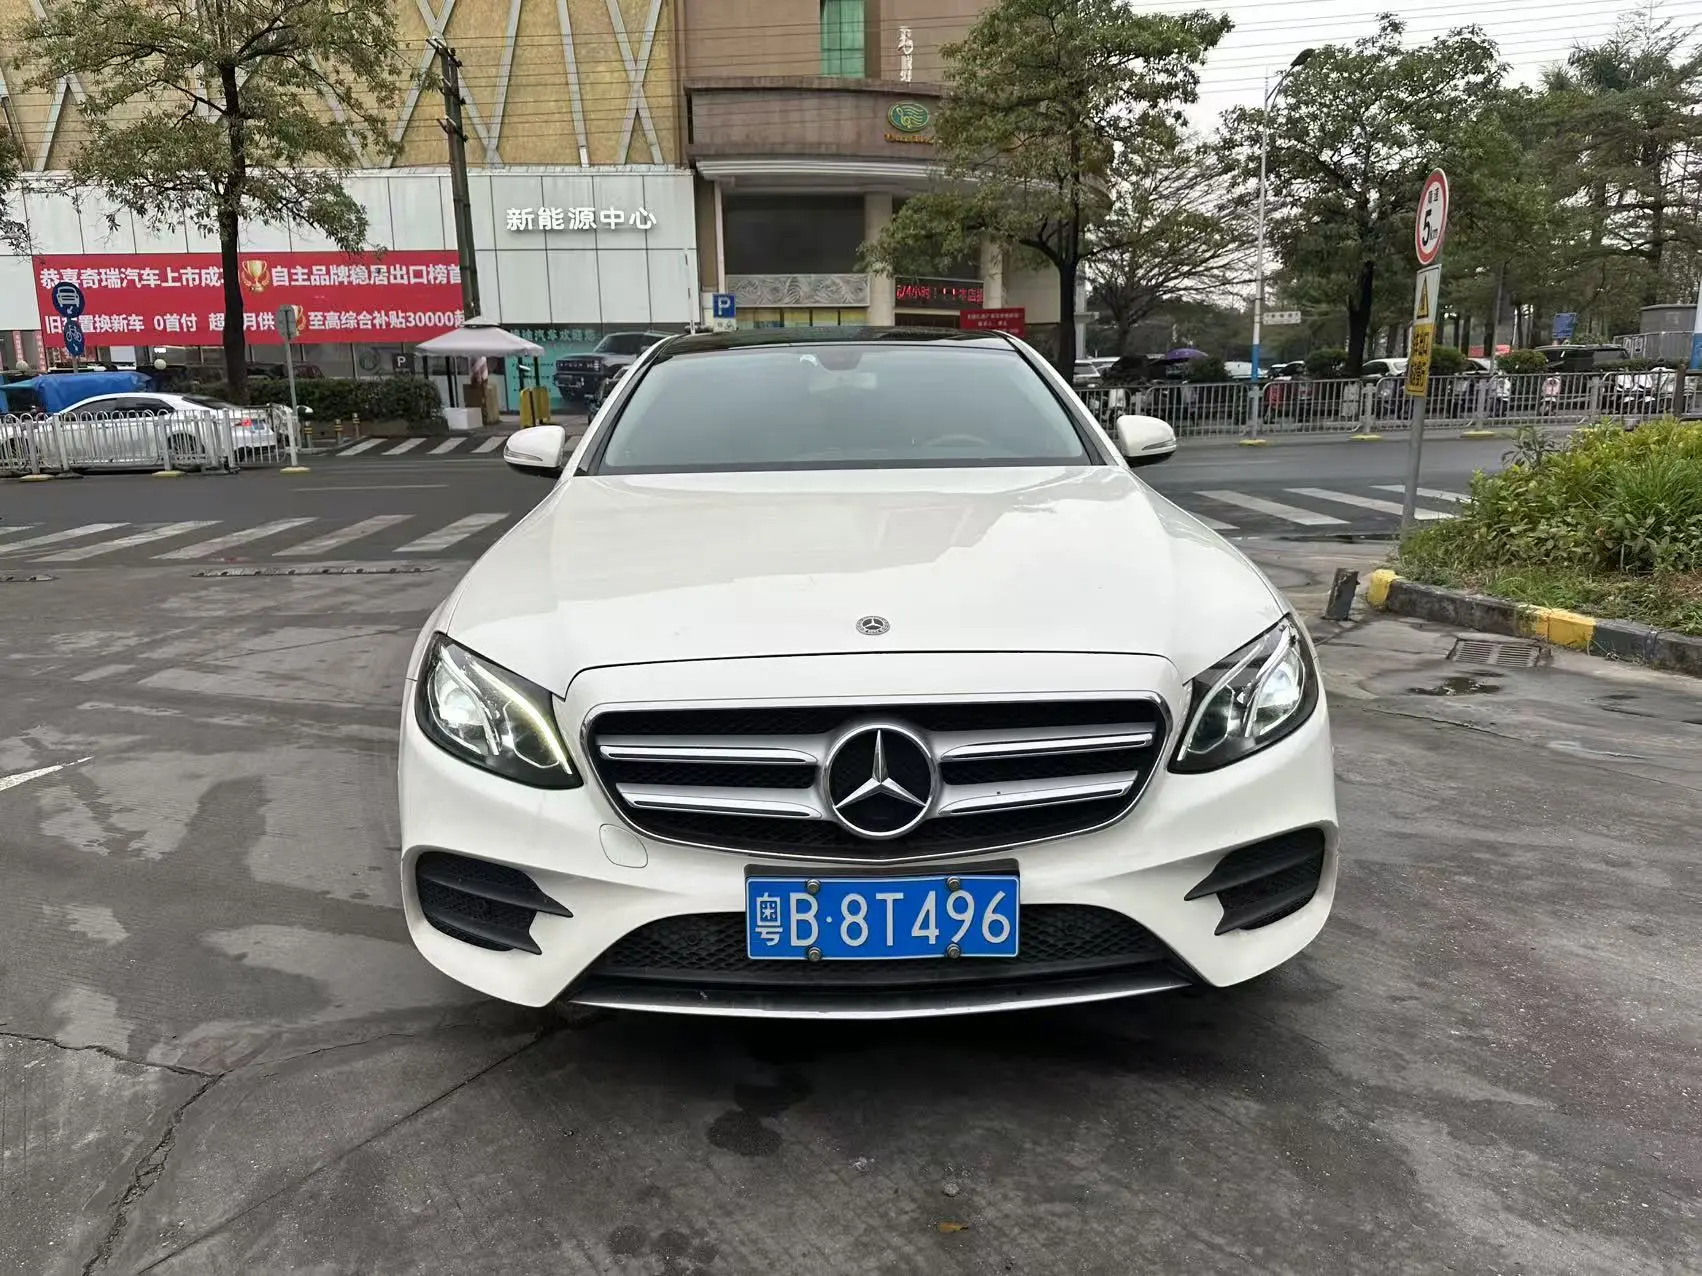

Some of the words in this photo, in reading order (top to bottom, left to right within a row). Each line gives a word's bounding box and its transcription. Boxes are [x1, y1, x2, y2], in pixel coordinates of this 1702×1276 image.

[505, 206, 657, 231] 新能源中心
[40, 267, 224, 289] 恭喜奇瑞汽车上市成
[718, 296, 731, 317] P
[45, 314, 145, 334] 旧置换新车
[153, 314, 198, 333] 0首付
[755, 889, 1011, 947] 粤B·8T496
